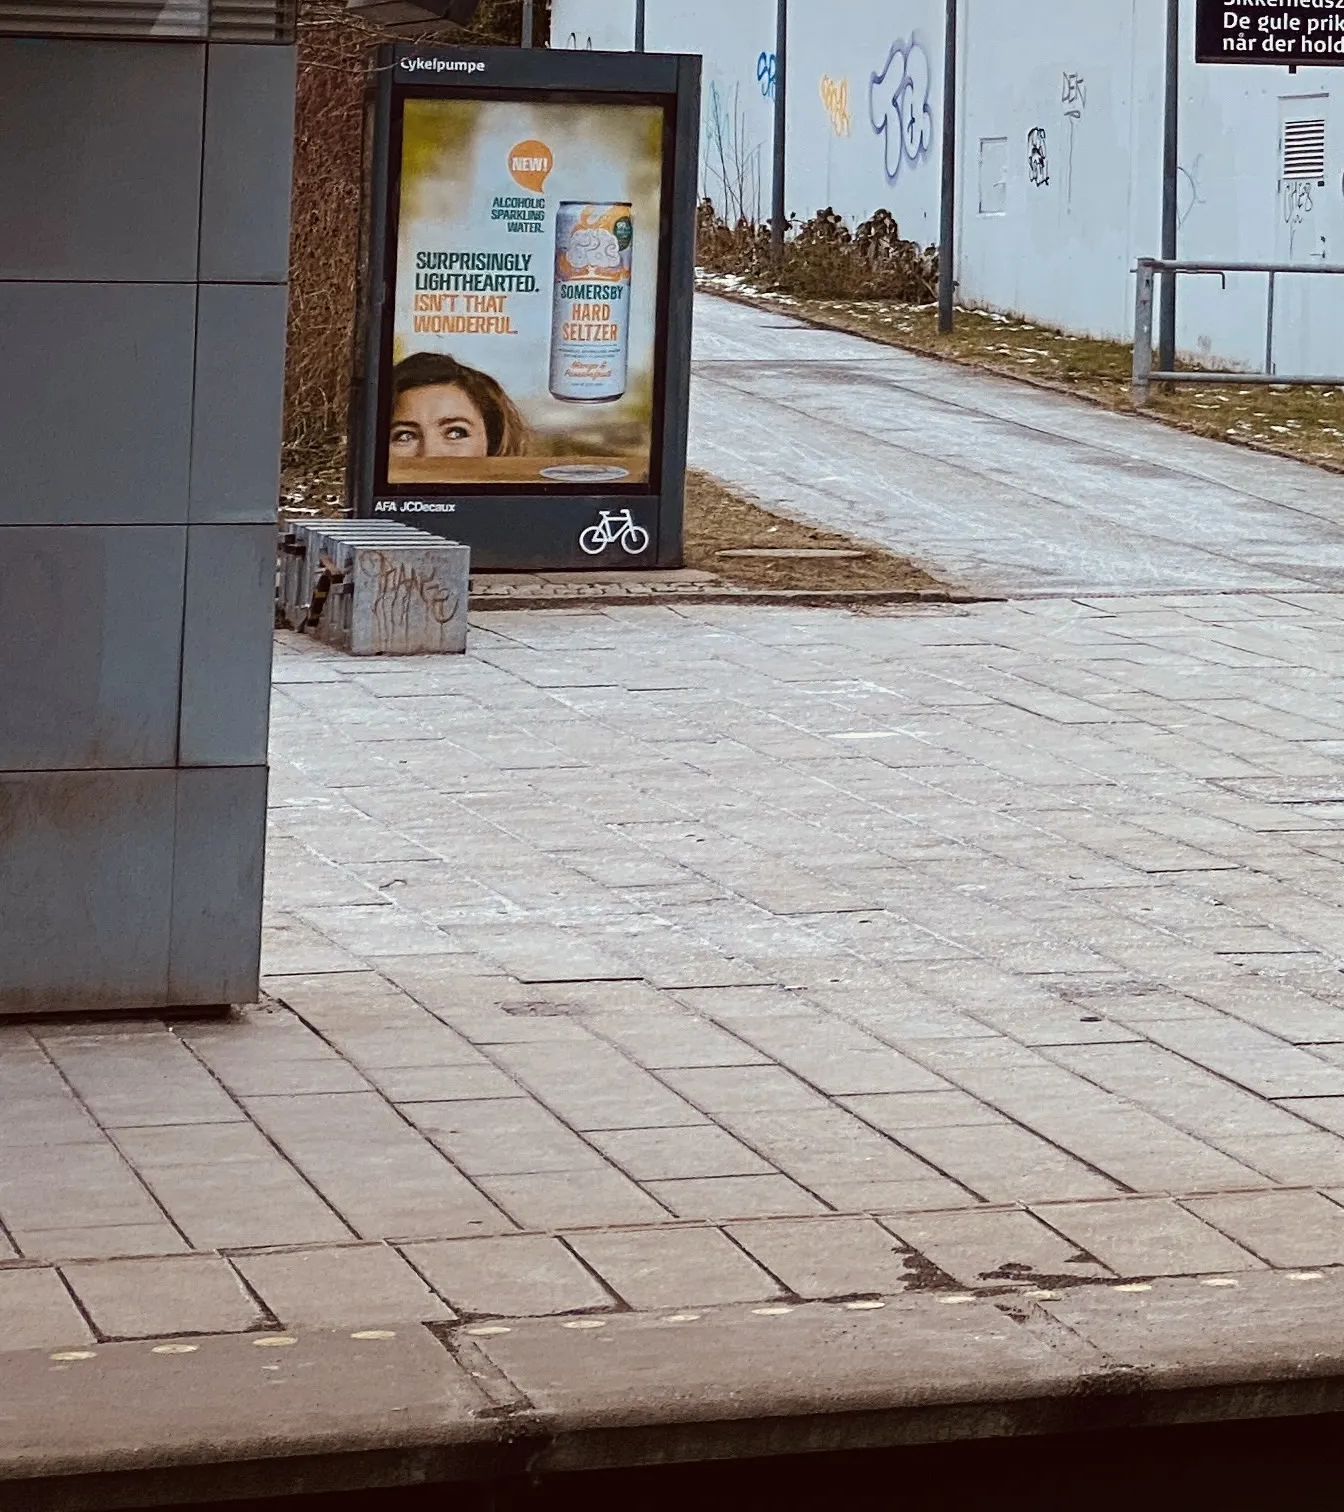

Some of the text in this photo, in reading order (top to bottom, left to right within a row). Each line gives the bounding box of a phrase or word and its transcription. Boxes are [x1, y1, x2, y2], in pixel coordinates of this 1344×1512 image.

[1223, 11, 1251, 29] De
[1257, 12, 1301, 34] gule
[1222, 32, 1256, 51] når
[1261, 34, 1296, 52] der
[400, 56, 486, 74] Cykelpumpe
[511, 156, 548, 173] NEW!
[492, 197, 546, 210] ALCOHOLIC
[490, 209, 545, 221] SPARKLING
[415, 251, 533, 271] SURPRISINGLY
[415, 273, 540, 293] LIGHTHEARTED.
[560, 284, 624, 300] SOMERSBY
[413, 293, 508, 313] ISN'T THAT
[571, 303, 611, 321] HARD
[413, 315, 518, 335] WONDERFUL.
[562, 323, 618, 342] SELTZER
[374, 501, 456, 512] AFA JCDecaux
